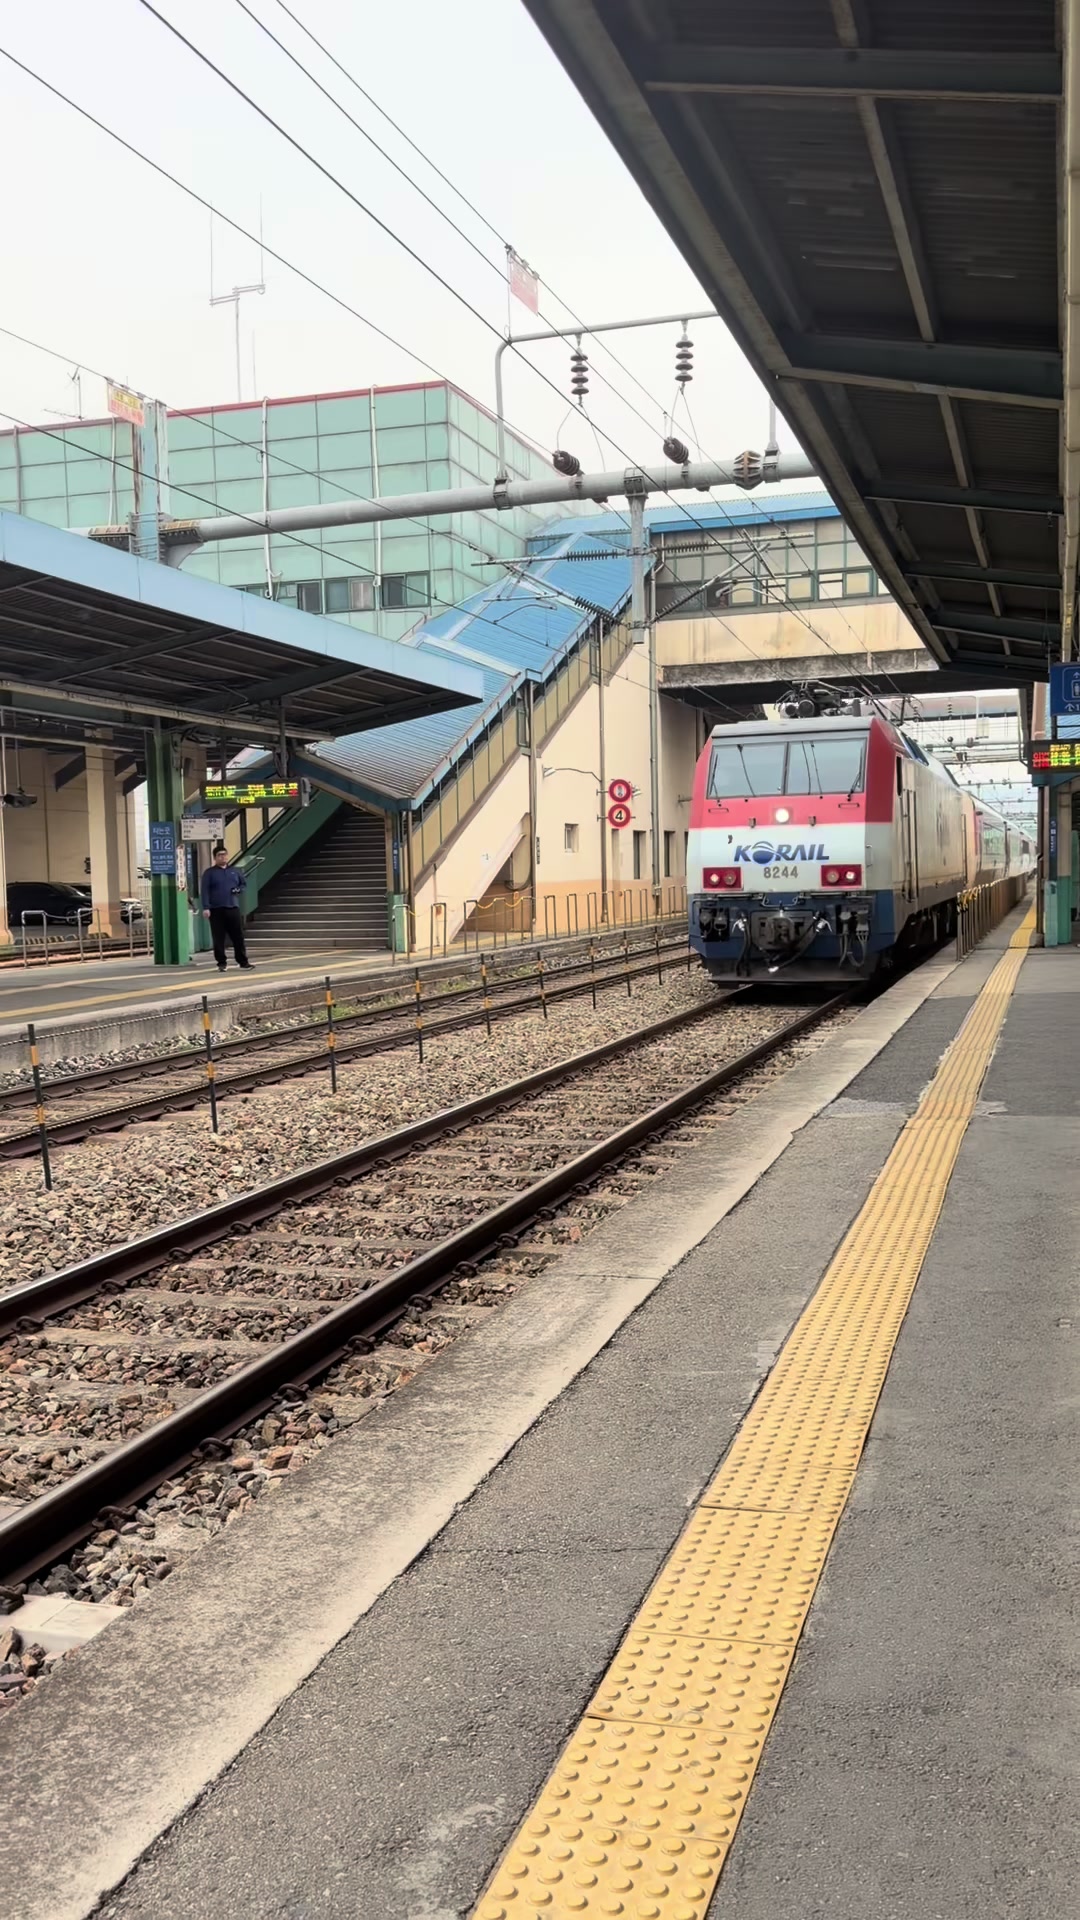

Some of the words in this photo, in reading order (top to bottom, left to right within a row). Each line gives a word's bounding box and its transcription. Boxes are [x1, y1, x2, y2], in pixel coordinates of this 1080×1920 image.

[615, 810, 623, 820] 4
[153, 839, 160, 850] 1
[164, 839, 171, 850] 2
[733, 841, 830, 865] KORAIL
[763, 866, 799, 879] 8244
